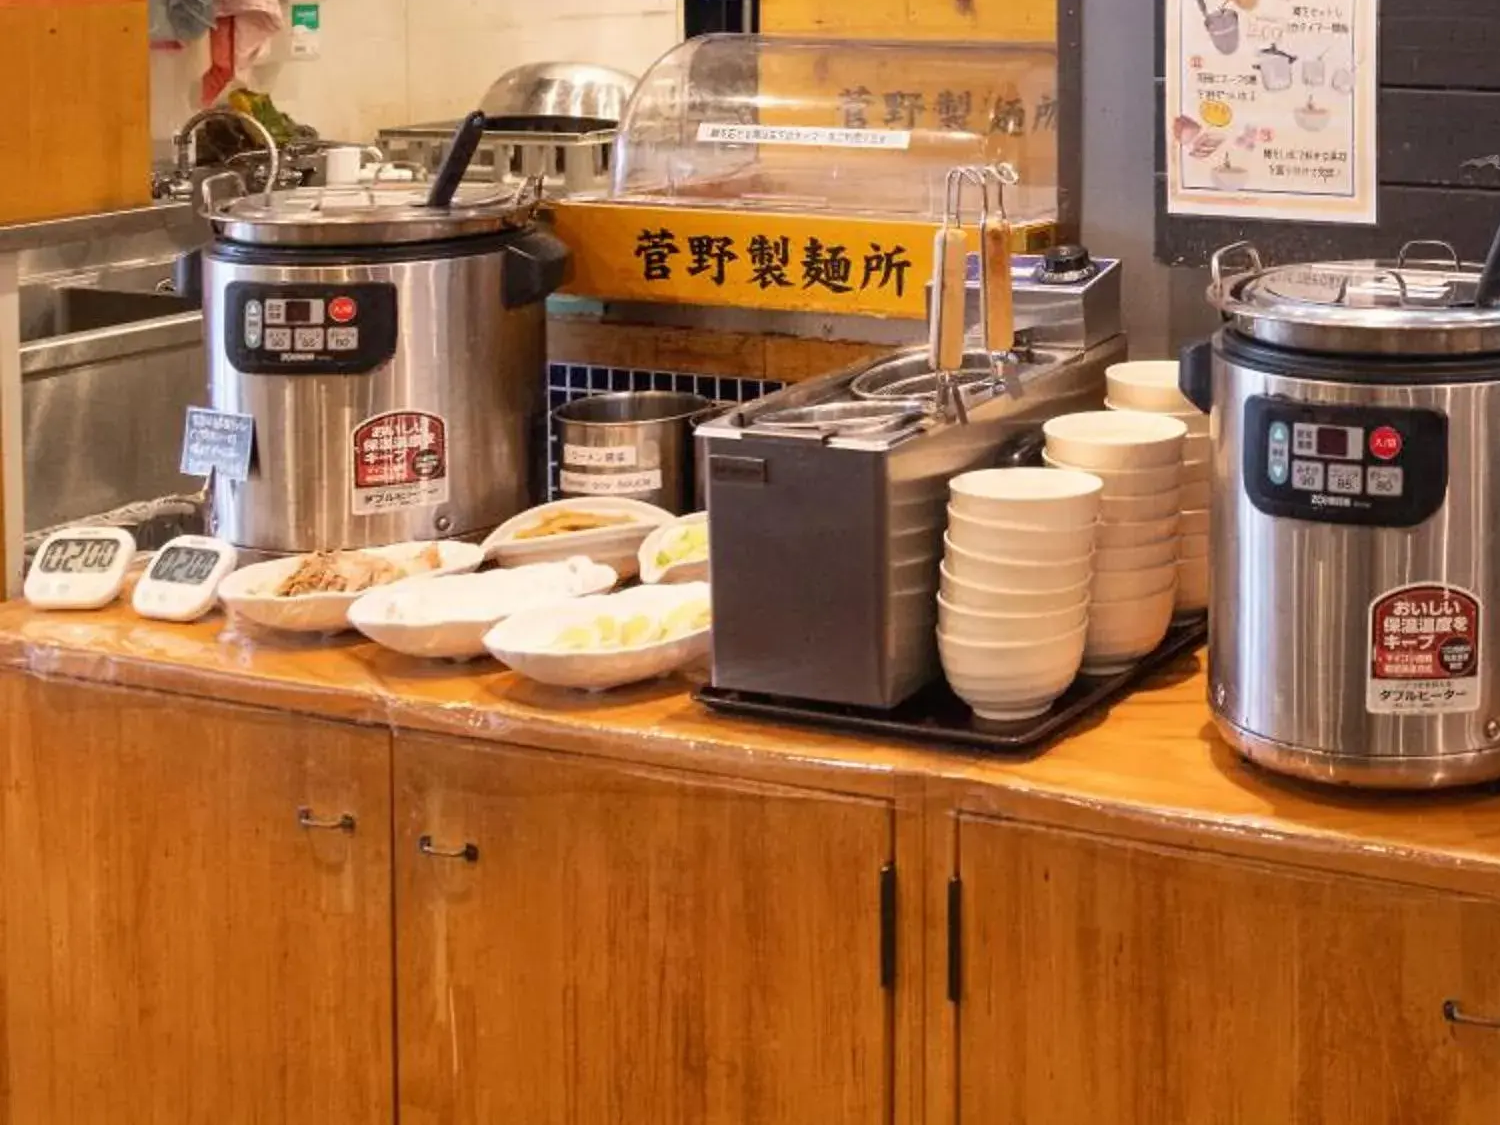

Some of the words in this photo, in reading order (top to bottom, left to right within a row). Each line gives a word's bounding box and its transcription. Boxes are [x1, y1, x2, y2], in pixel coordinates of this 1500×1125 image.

[634, 228, 912, 297] 菅野製麺所
[1393, 600, 1460, 615] おいしい
[1383, 634, 1435, 649] キープ
[1380, 690, 1467, 701] ダブルヒーター
